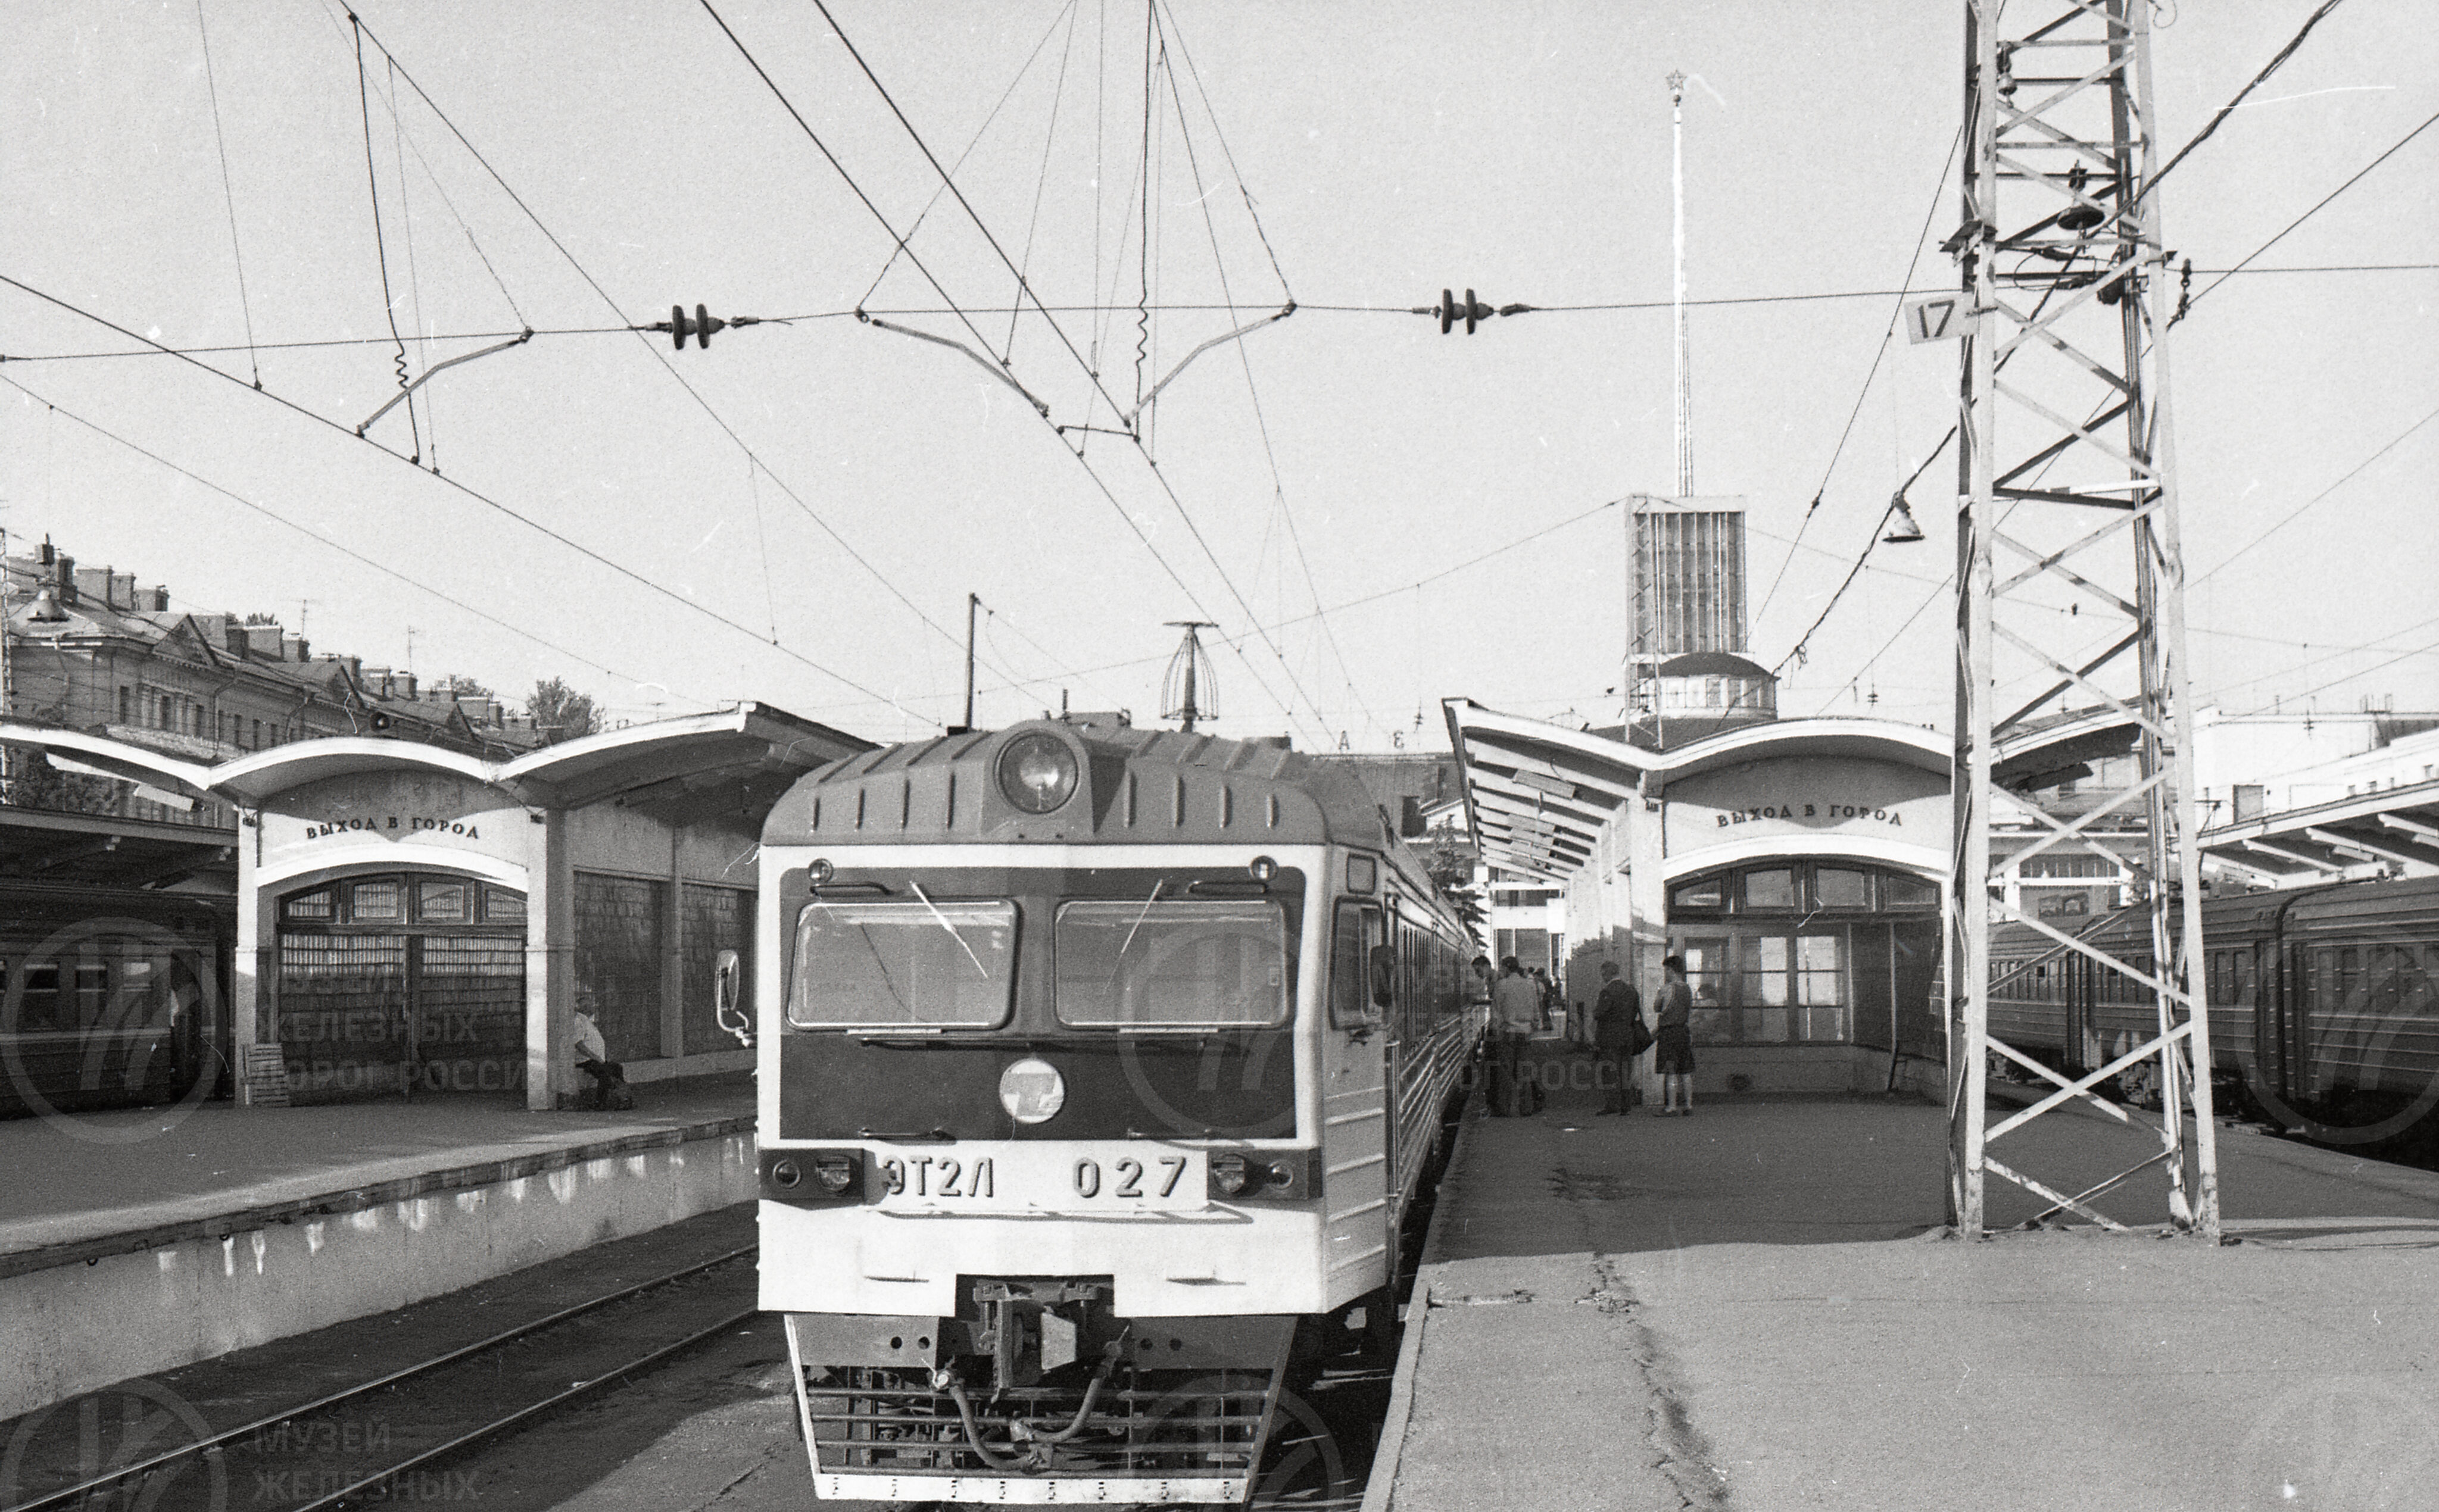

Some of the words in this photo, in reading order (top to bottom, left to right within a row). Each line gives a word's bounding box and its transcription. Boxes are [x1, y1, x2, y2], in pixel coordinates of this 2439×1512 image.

[1917, 299, 1955, 339] 17
[306, 817, 377, 839] ВЫХОД
[388, 817, 398, 829] В
[411, 817, 479, 839] ГОРОД
[1716, 805, 1792, 827] ВЫХОД
[1804, 804, 1816, 817] В
[1829, 804, 1902, 826] ГОРОД
[882, 1155, 994, 1198] ЭТ2Л
[1075, 1155, 1187, 1198] 027
